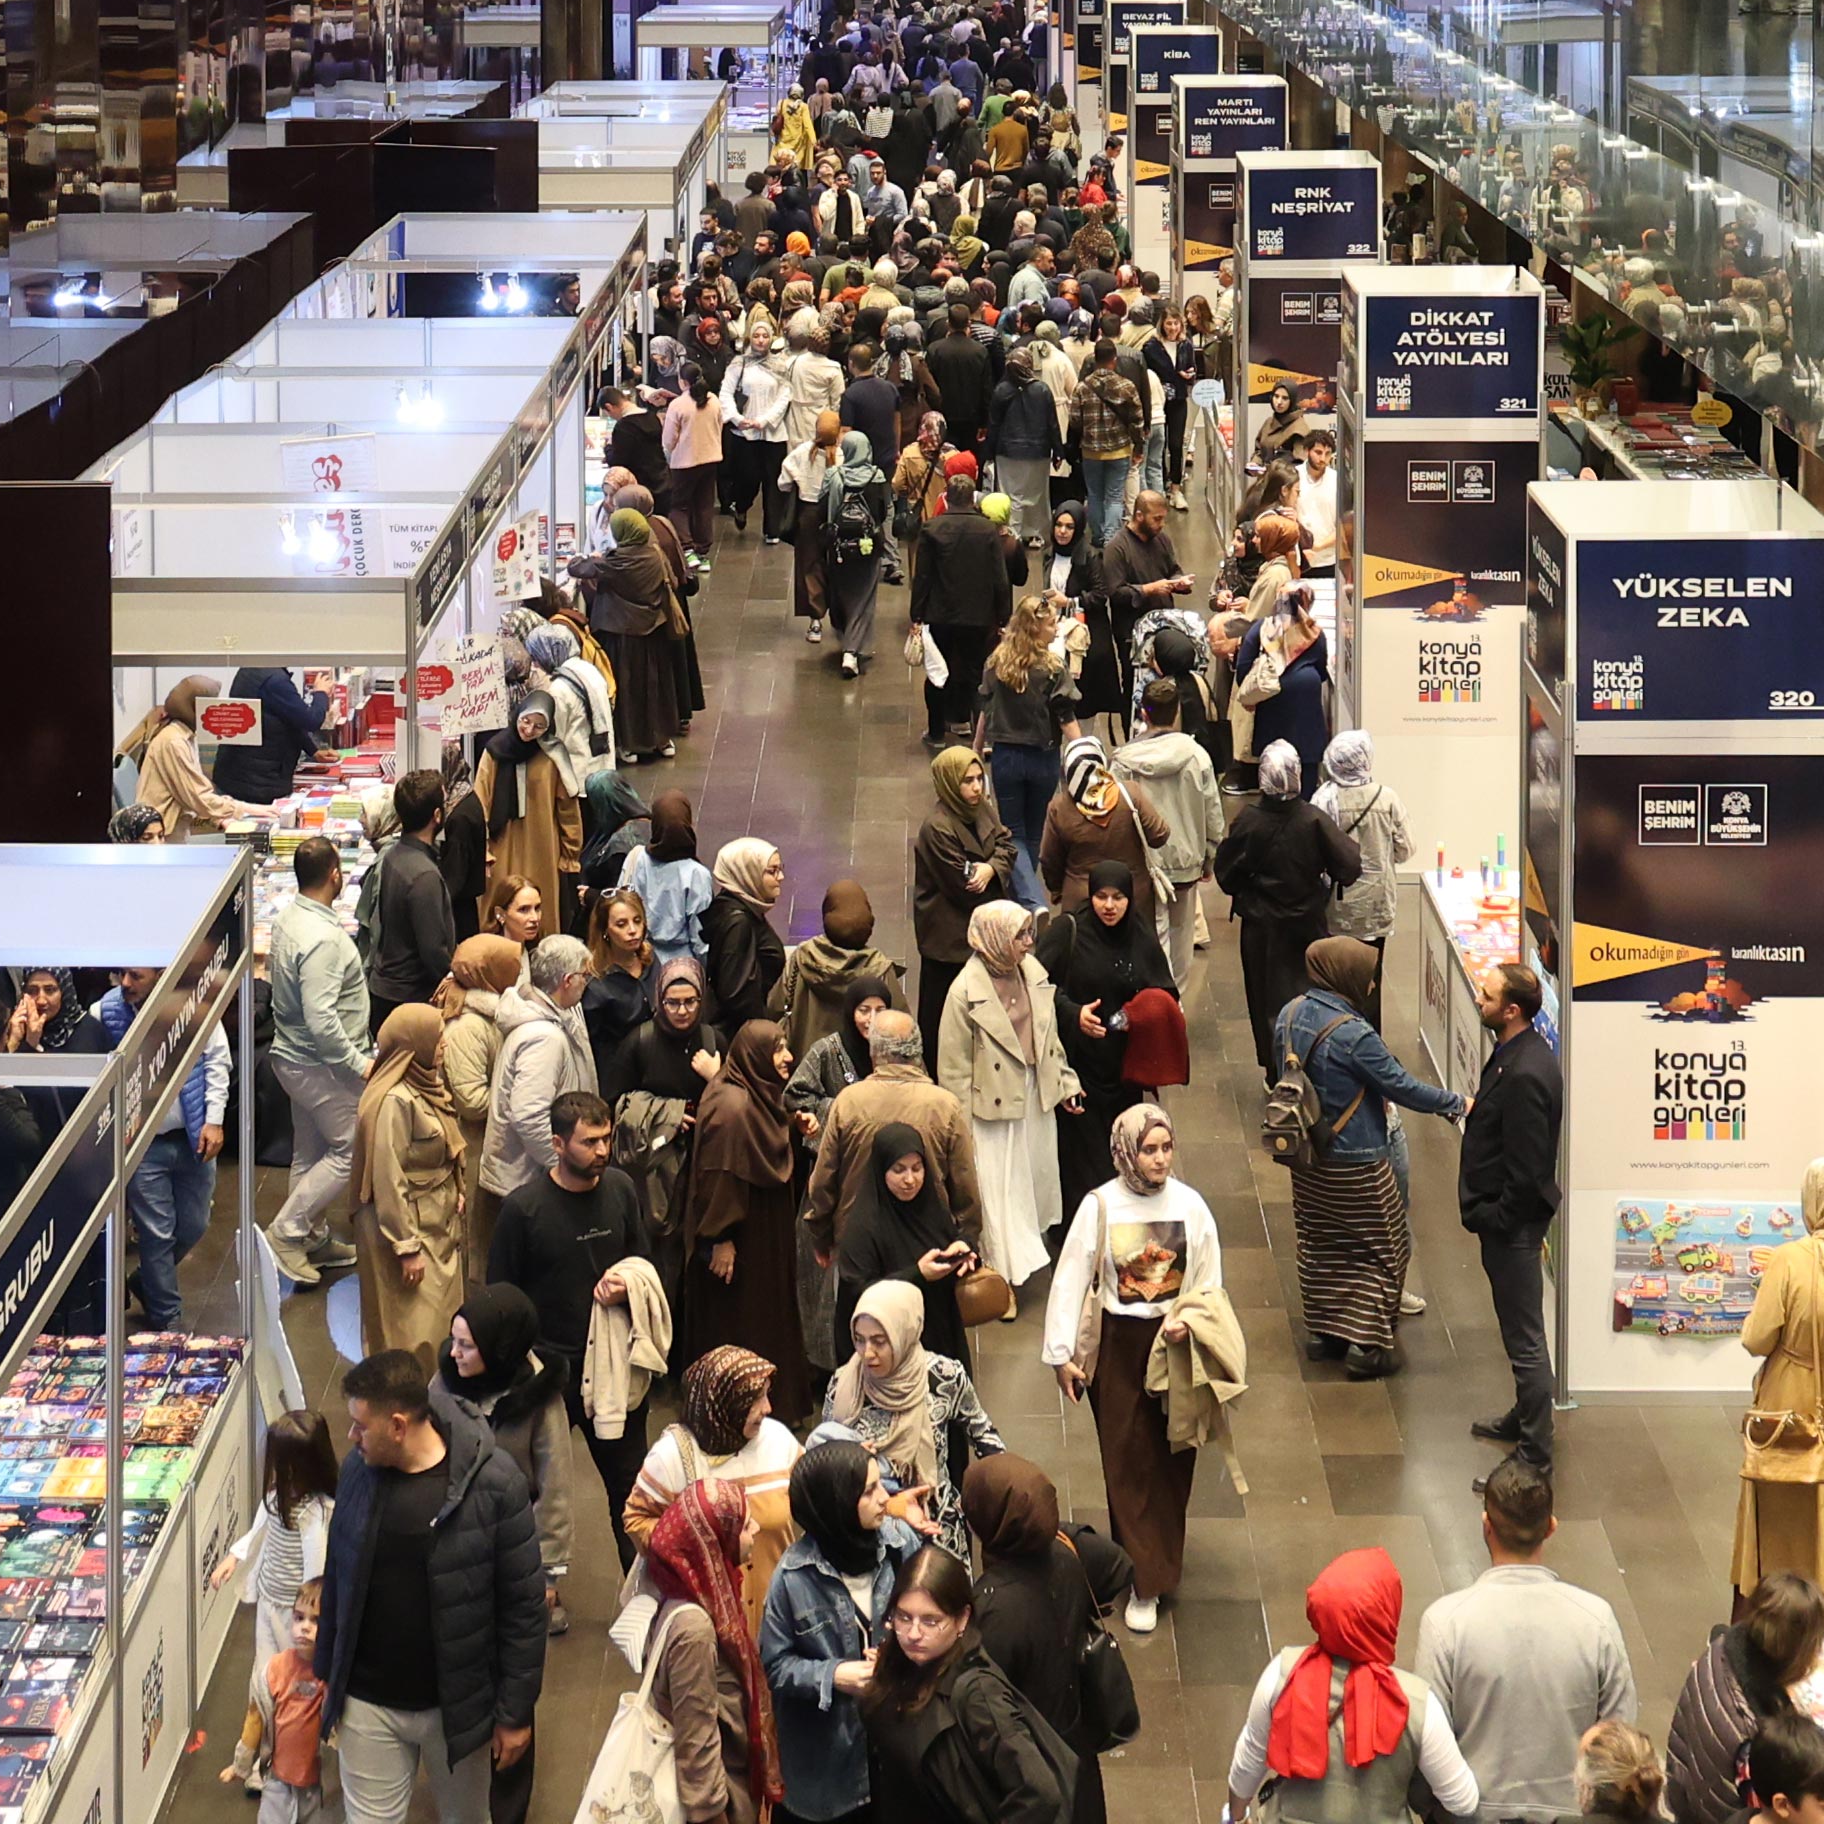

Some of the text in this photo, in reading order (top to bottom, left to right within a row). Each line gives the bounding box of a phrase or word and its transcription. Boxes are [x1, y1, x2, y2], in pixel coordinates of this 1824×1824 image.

[1156, 12, 1172, 21] FİL
[1163, 49, 1191, 59] KİBA
[1207, 108, 1263, 116] YAYINLARI
[1220, 117, 1275, 125] YAYINLARI
[1295, 187, 1331, 198] RNK
[1271, 201, 1355, 216] NEŞRİYAT
[1347, 243, 1370, 252] 322
[1410, 309, 1494, 326] DİKKAT
[1397, 328, 1505, 346] ATÖLYESİ
[1393, 351, 1509, 366] YAYINLARI
[1377, 376, 1411, 388] konya
[1377, 386, 1411, 398] kitap
[1500, 398, 1527, 409] 321
[411, 524, 438, 532] KİTAPL
[356, 539, 369, 576] ÇOCUK
[1532, 535, 1561, 587] YÜKSELEN
[1538, 572, 1554, 607] ZEKA
[1612, 573, 1792, 598] YÜKSELEN
[1657, 607, 1750, 627] ZEKA
[1420, 640, 1481, 659] konya
[1419, 657, 1481, 678] kitap
[1593, 659, 1643, 676] konya
[1419, 677, 1481, 694] günleri
[1593, 673, 1643, 691] kitap
[1593, 688, 1643, 703] günleri
[1769, 690, 1815, 706] 320
[1590, 942, 1805, 963] okumadığın gün karanlıktasın
[148, 933, 229, 1091] X10 YAYIN GRUBU
[1731, 1040, 1747, 1051] 13.
[1655, 1048, 1747, 1077] konya
[1655, 1073, 1746, 1105] kitap
[1654, 1103, 1746, 1129] günleri
[1630, 1161, 1770, 1170] www.konyakitapgunleri.com
